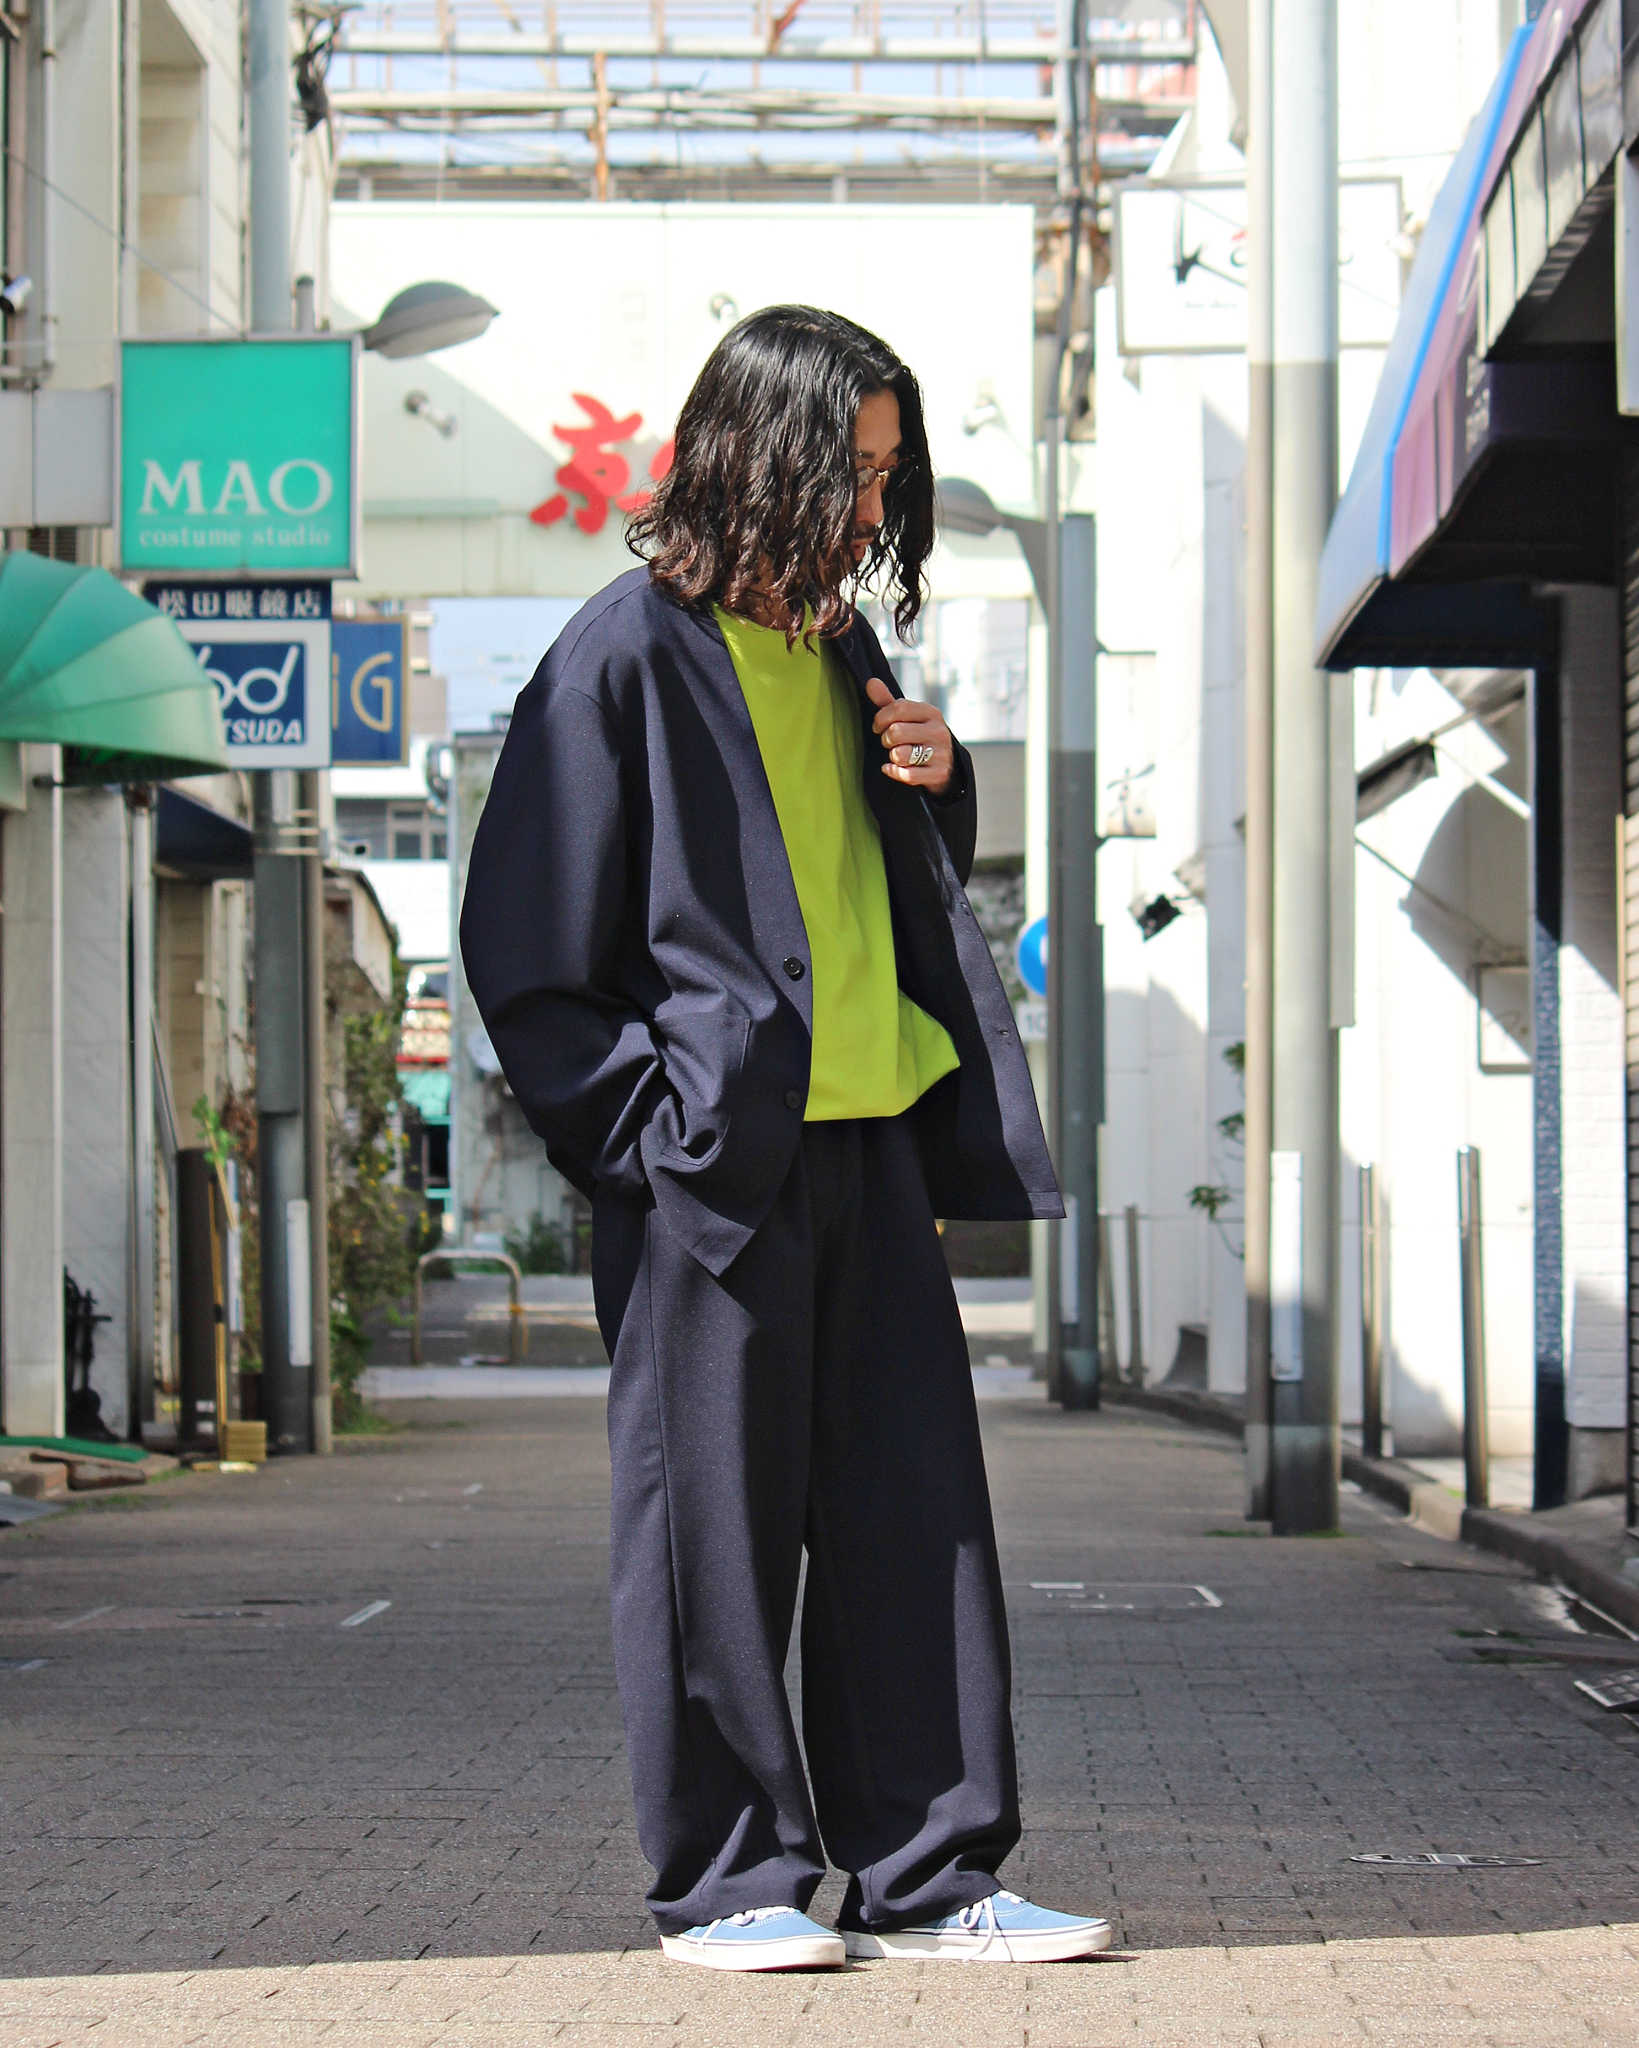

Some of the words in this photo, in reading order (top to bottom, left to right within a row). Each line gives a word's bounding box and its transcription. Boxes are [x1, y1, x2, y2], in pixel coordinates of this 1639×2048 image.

[139, 458, 333, 516] MAO
[139, 526, 241, 548] costume
[252, 522, 331, 548] studio
